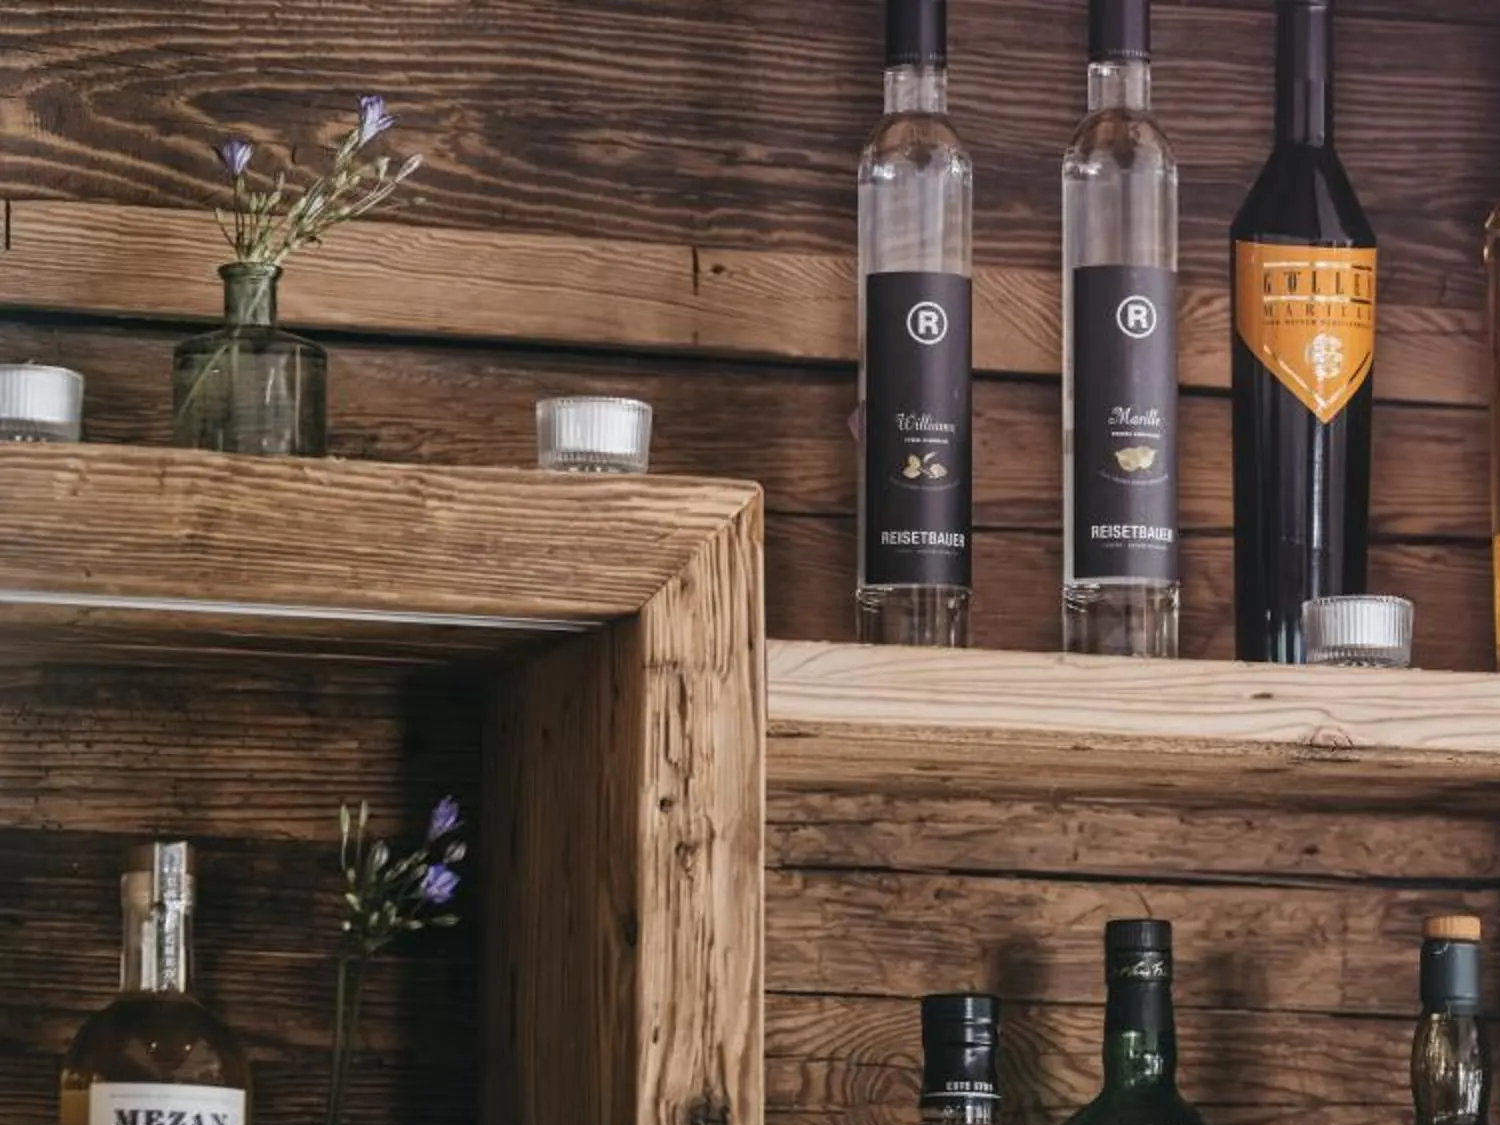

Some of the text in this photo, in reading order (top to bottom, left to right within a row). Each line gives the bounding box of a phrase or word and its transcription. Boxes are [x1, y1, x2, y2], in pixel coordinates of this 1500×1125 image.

[1108, 406, 1161, 427] Marille
[881, 531, 965, 548] REISETBAUER
[1091, 525, 1173, 542] REISETBAUER
